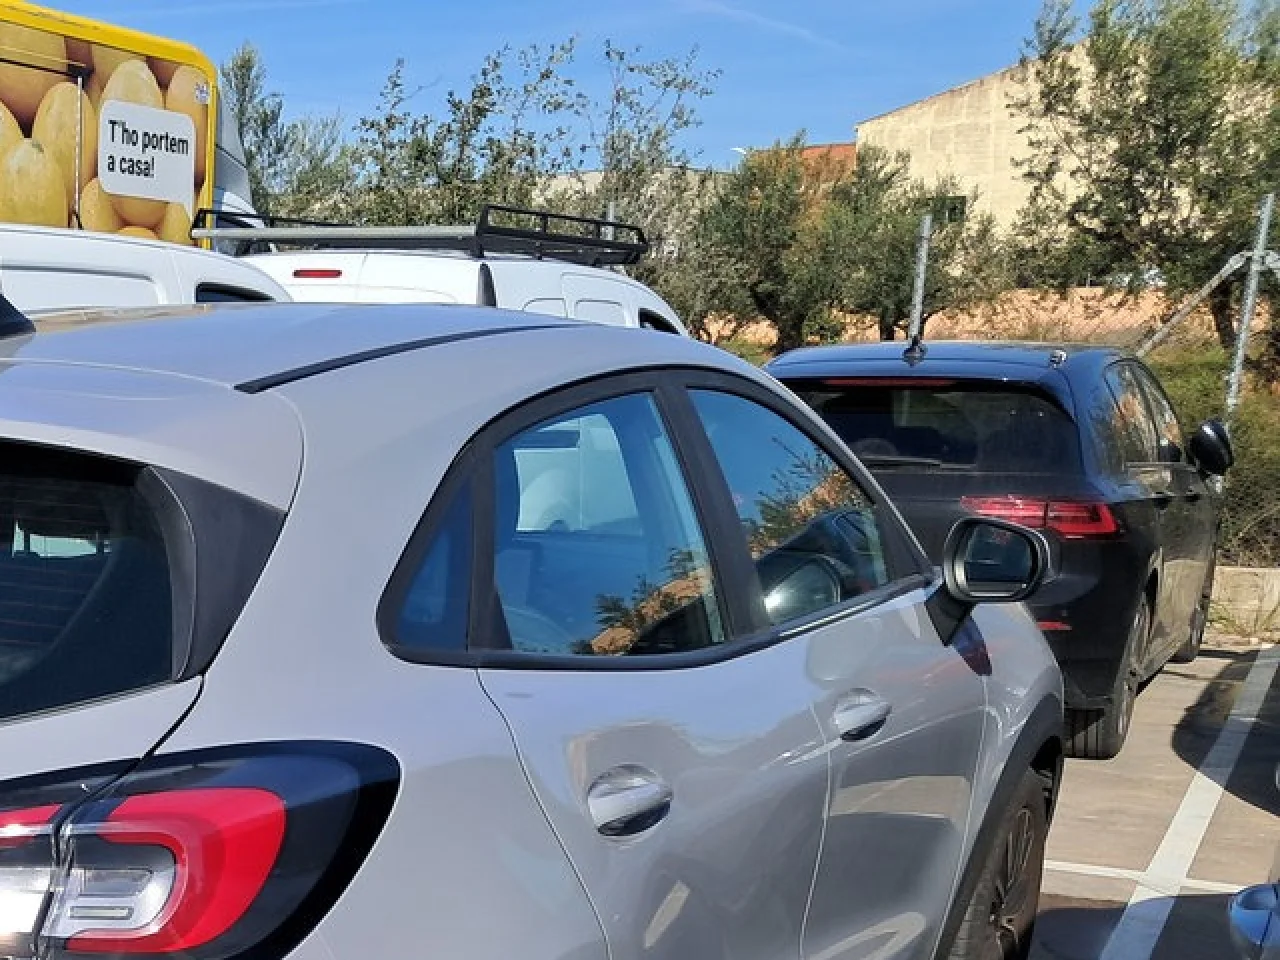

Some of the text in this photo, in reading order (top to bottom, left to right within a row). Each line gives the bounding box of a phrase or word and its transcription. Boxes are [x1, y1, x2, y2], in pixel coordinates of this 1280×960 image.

[108, 119, 190, 156] T'ho portem
[107, 154, 155, 178] a casa!
